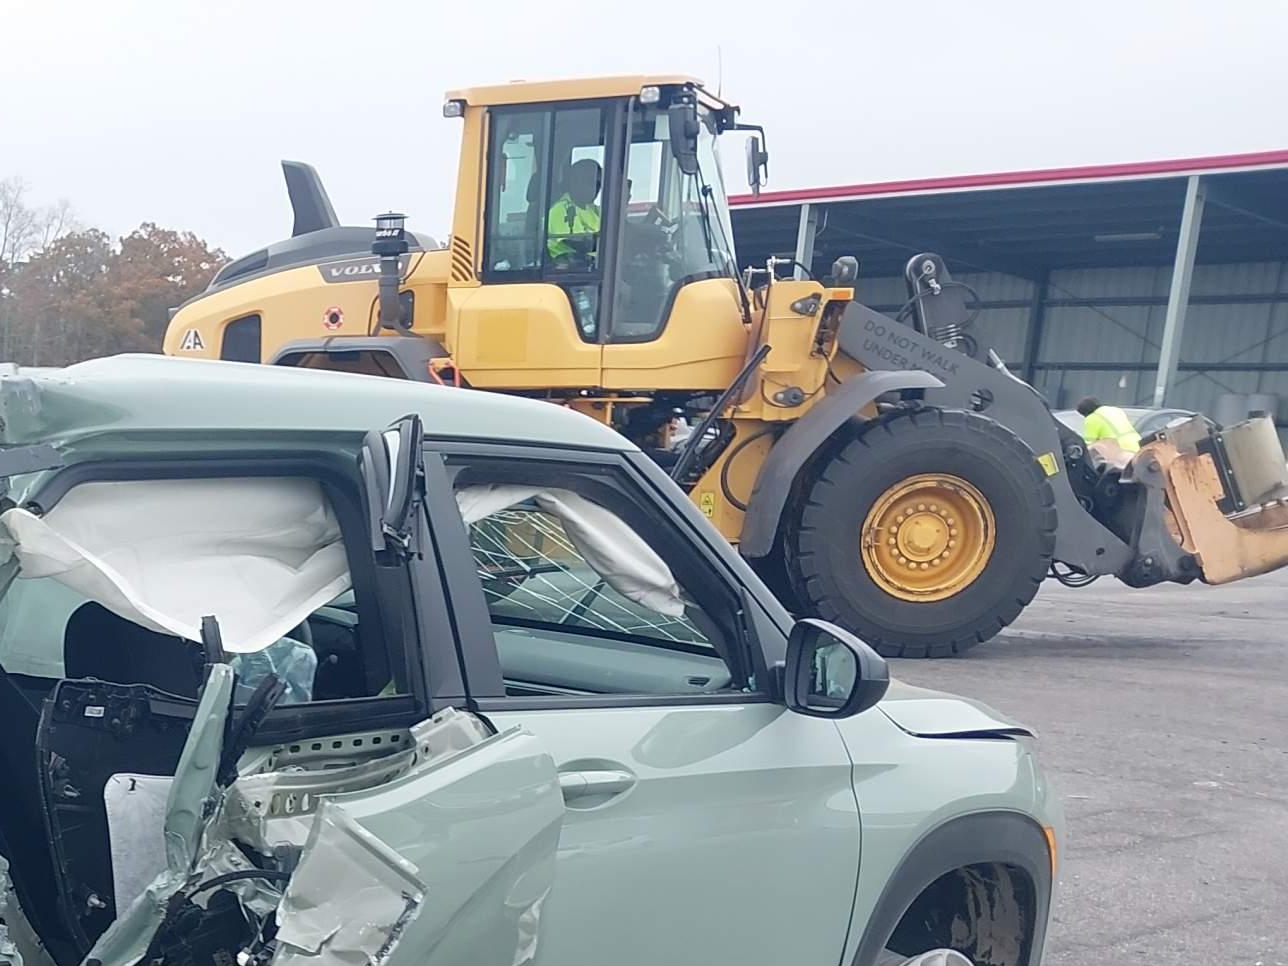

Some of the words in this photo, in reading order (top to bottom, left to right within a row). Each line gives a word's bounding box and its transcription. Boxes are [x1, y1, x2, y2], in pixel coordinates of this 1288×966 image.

[862, 338, 909, 369] UNDER
[863, 319, 886, 337] DO
[887, 331, 920, 353] NOT
[920, 346, 961, 376] WALK
